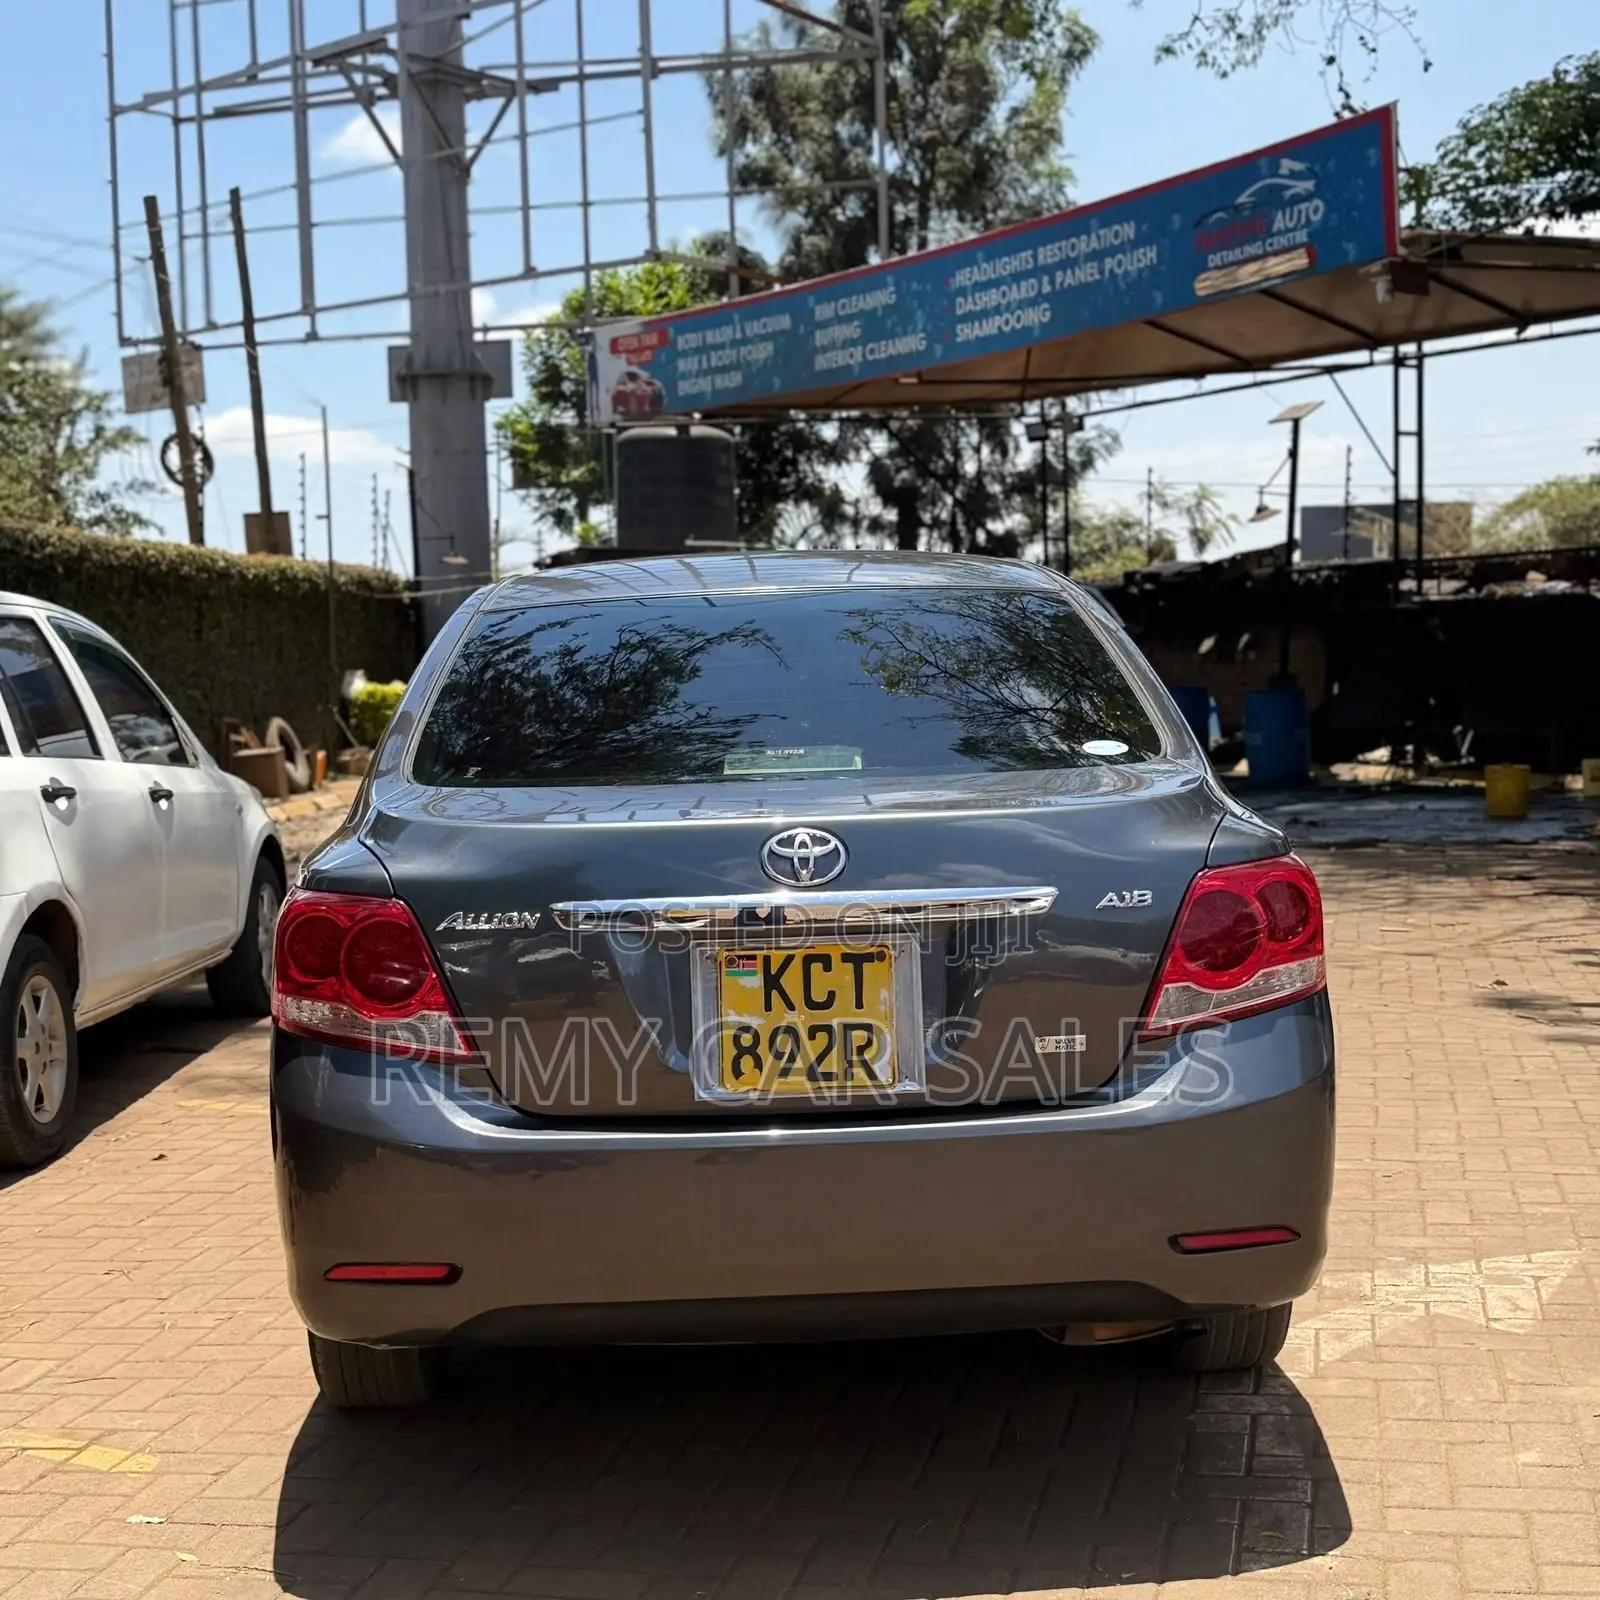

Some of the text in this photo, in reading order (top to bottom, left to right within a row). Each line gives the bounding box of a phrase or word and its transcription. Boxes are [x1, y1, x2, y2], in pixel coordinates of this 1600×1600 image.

[1272, 198, 1325, 233] AUTO
[955, 220, 1136, 287] HEADLIGHTS RESTORATION
[1207, 241, 1264, 268] DETAILING
[1265, 228, 1309, 252] CENTRE
[955, 245, 1158, 316] DASHBOARD & PANEL POLISH
[837, 286, 898, 316] CLEANING
[955, 303, 1051, 343] SHAMPOOING
[865, 332, 928, 361] CLEANING
[435, 910, 541, 933] ALLION
[763, 951, 876, 1013] KCT
[731, 1022, 879, 1083] 892R
